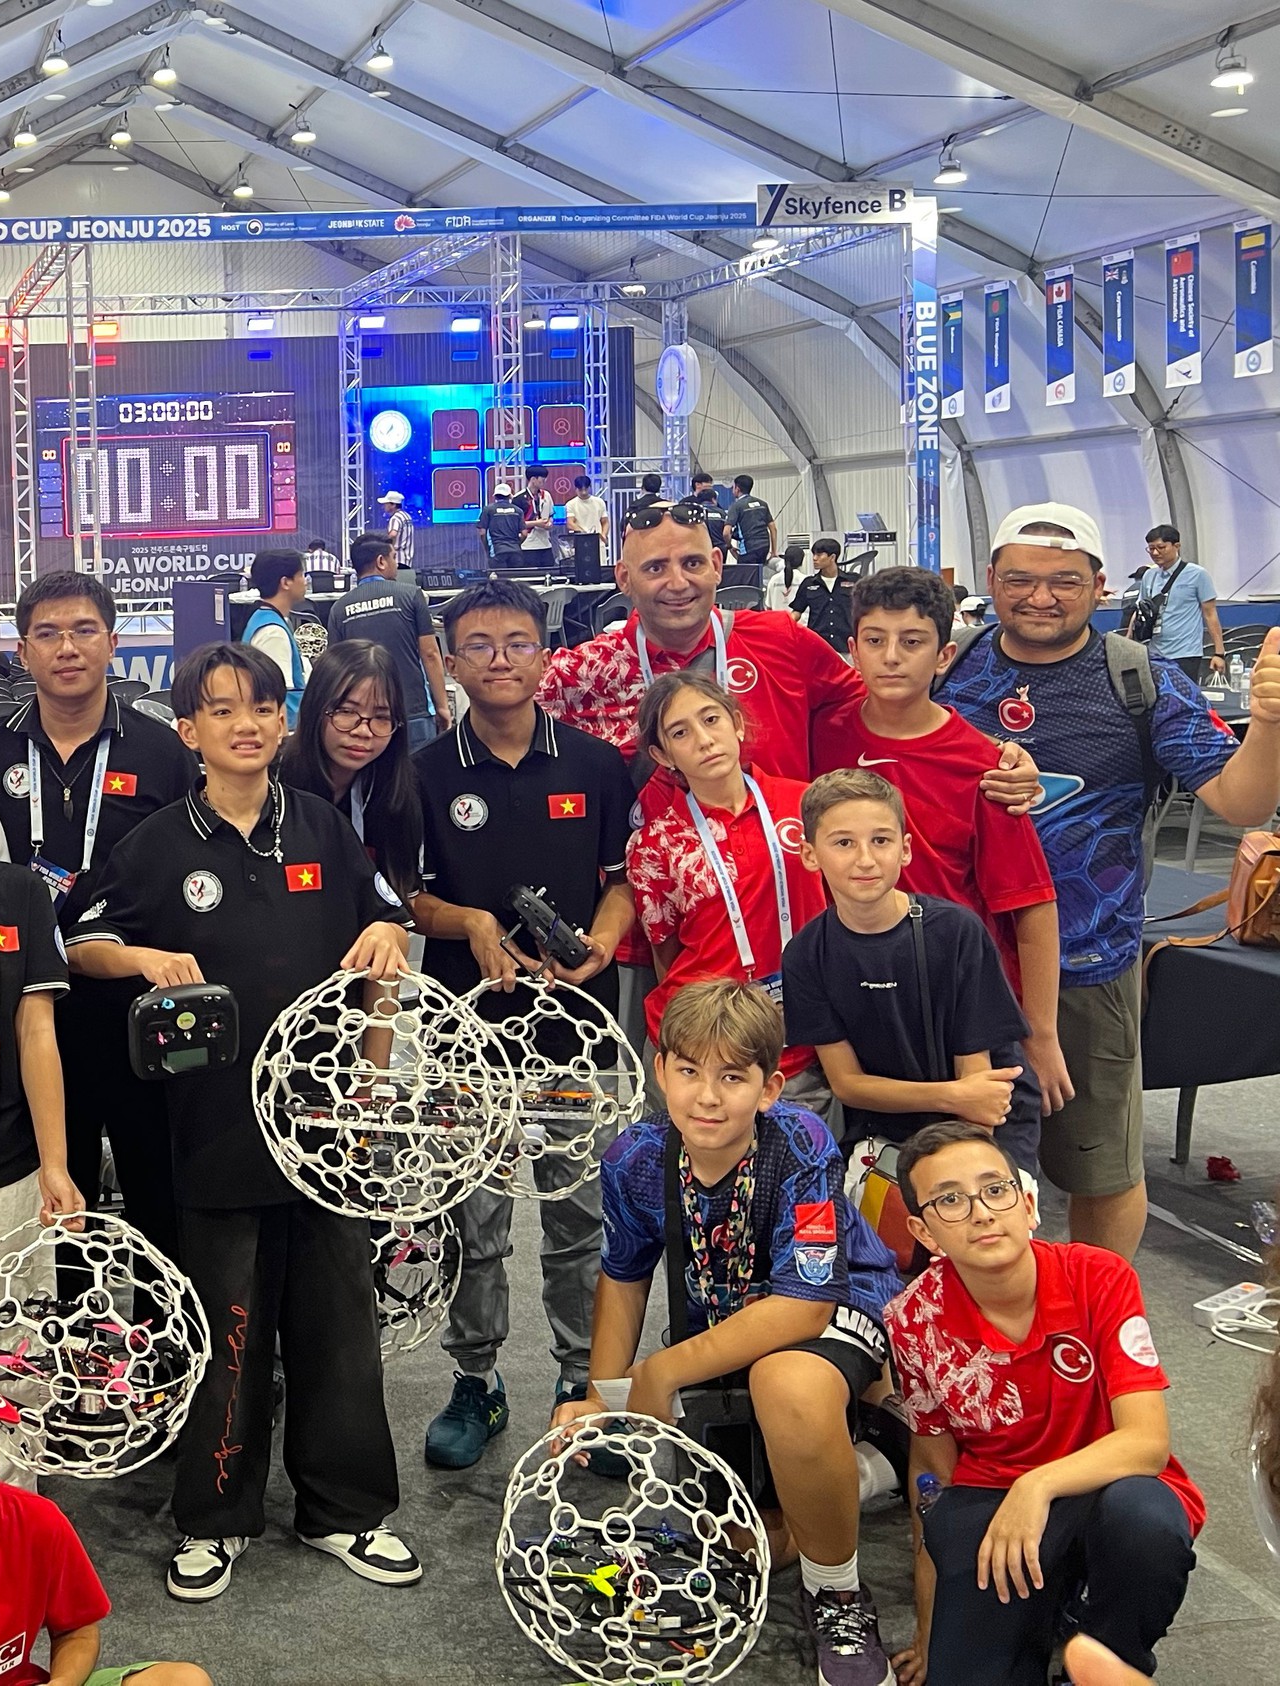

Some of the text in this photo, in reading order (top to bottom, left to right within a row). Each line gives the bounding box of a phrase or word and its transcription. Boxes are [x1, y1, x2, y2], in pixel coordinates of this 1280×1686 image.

[784, 189, 907, 219] Skyfence B
[11, 220, 62, 240] CUP
[66, 218, 154, 240] JEONJU
[157, 218, 211, 238] 2025
[574, 214, 611, 224] Organizing
[612, 213, 649, 222] Committee
[667, 213, 688, 221] World
[689, 213, 704, 222] Cup
[730, 212, 747, 220] 2025
[915, 301, 937, 371] BLUE
[119, 400, 214, 423] 03:00:00
[917, 377, 938, 451] ZONE
[133, 554, 211, 574] WORLD
[213, 552, 257, 571] CUP
[111, 576, 181, 593] JEONJ
[836, 1305, 886, 1353] NIKE
